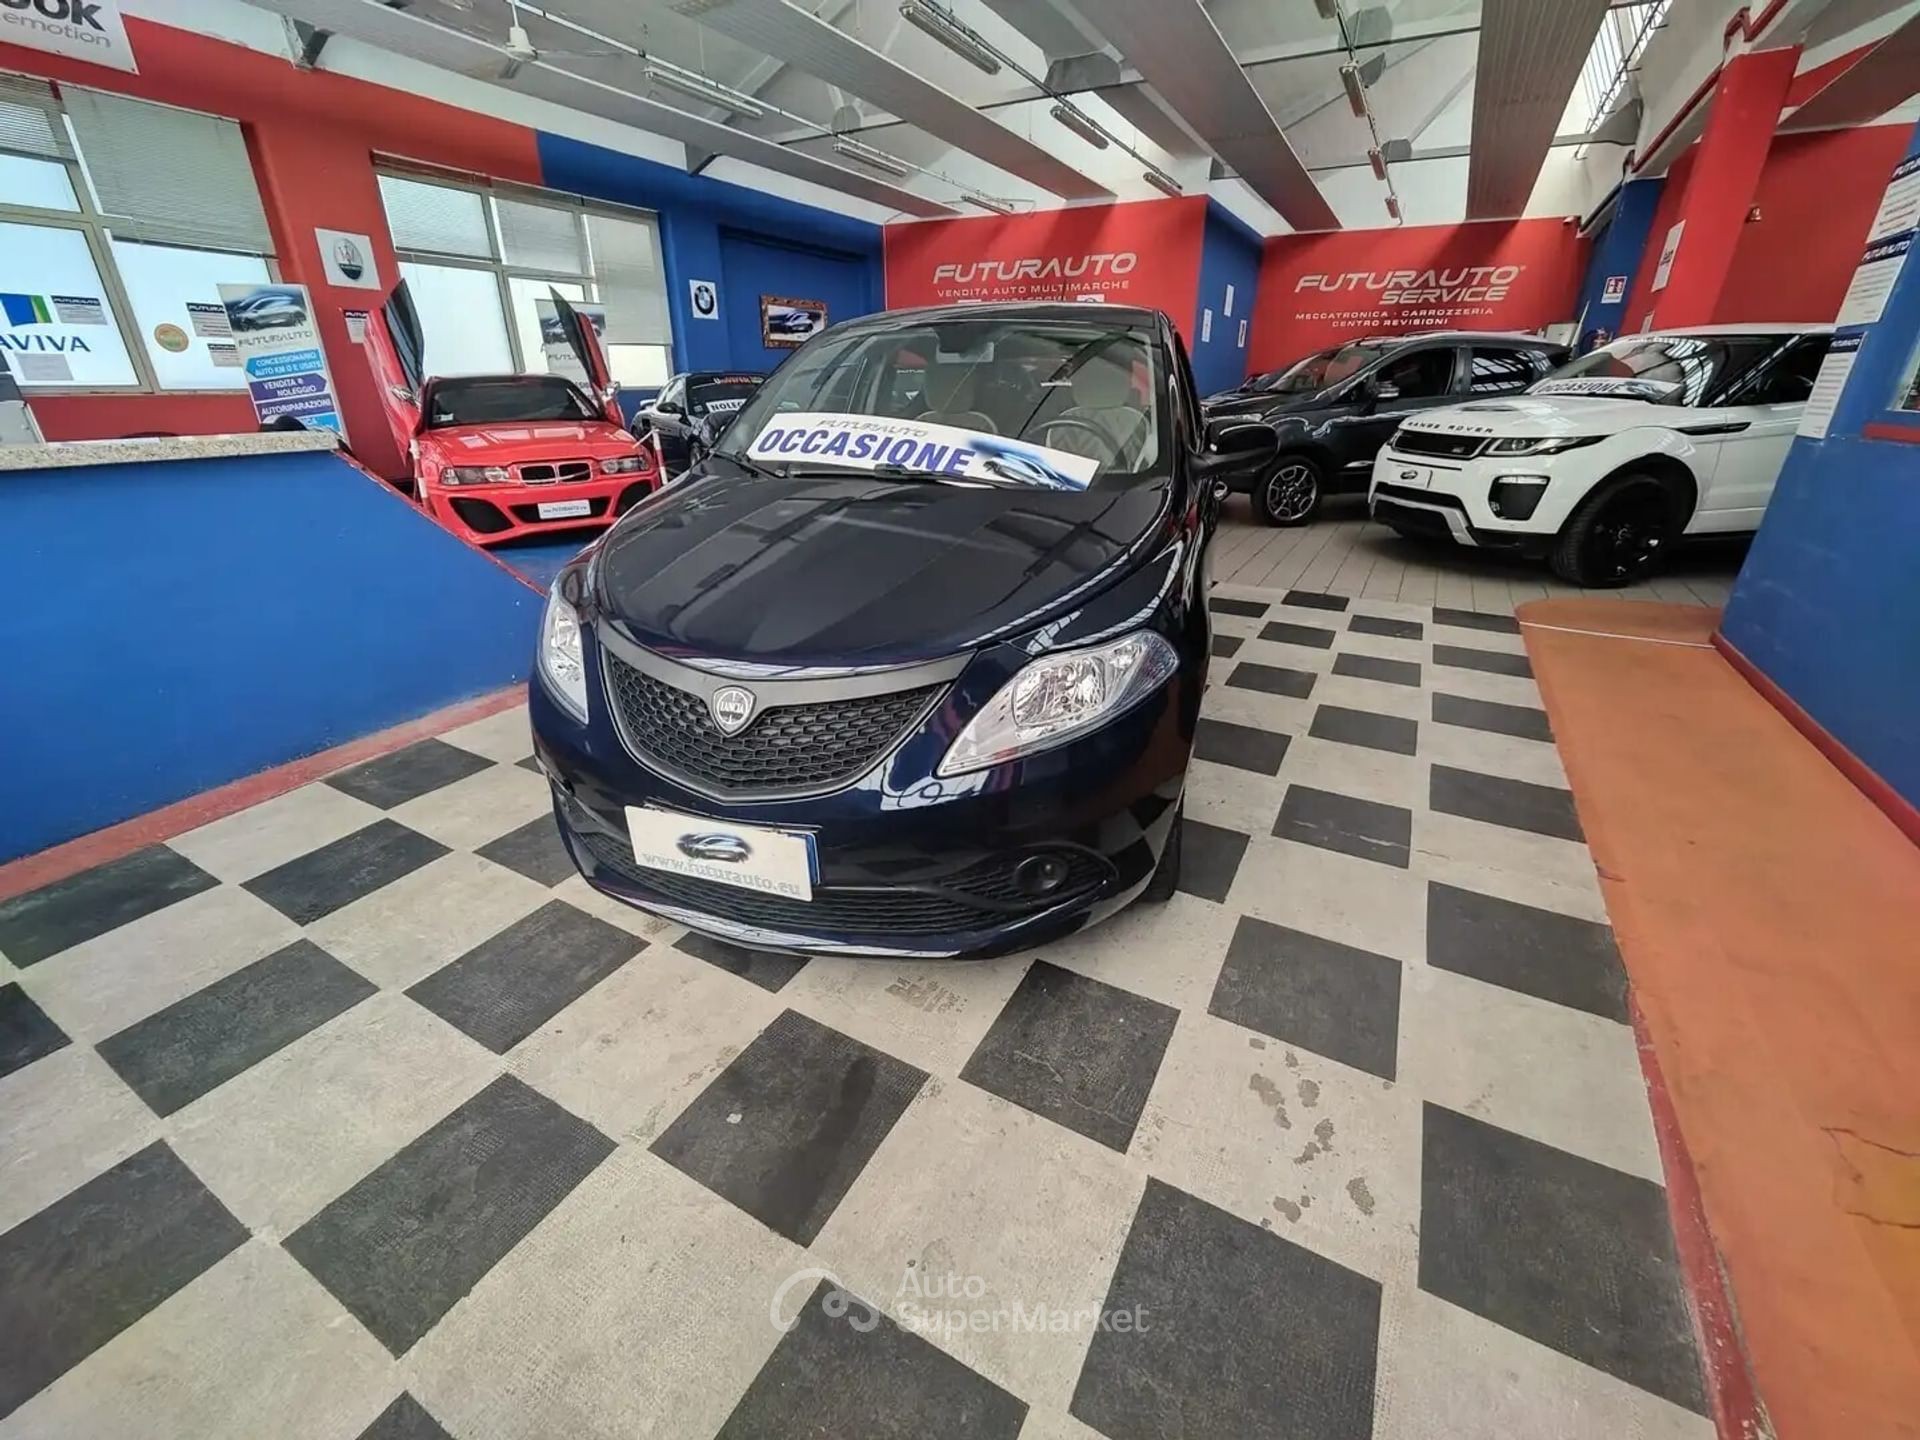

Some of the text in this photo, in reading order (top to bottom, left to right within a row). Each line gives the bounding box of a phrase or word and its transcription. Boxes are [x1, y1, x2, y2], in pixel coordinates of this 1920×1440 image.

[2, 12, 111, 48] emotion
[933, 252, 1138, 285] FUTURAUTO
[1294, 265, 1519, 293] FUTURAUTO
[937, 288, 989, 298] VENDITA
[992, 286, 1026, 295] AUTO
[1030, 280, 1130, 294] MULTIMARCHE
[1379, 285, 1510, 306] SERVICE
[1295, 308, 1494, 320] MECCATRONICA CARROZZERIA
[1332, 318, 1449, 328] CENTRO REVISIONI
[0, 335, 91, 352] AVIVA
[238, 330, 313, 347] FUTURAUTO
[262, 379, 296, 390] VENDITA
[276, 385, 316, 397] NOLEGGIO
[261, 398, 331, 415] AUTORIPARAZIONI
[816, 420, 929, 437] FUTURAUTO
[1448, 425, 1494, 433] ROVER
[758, 429, 977, 476] OCCASIONE
[642, 853, 801, 895] www.futurauto.eu
